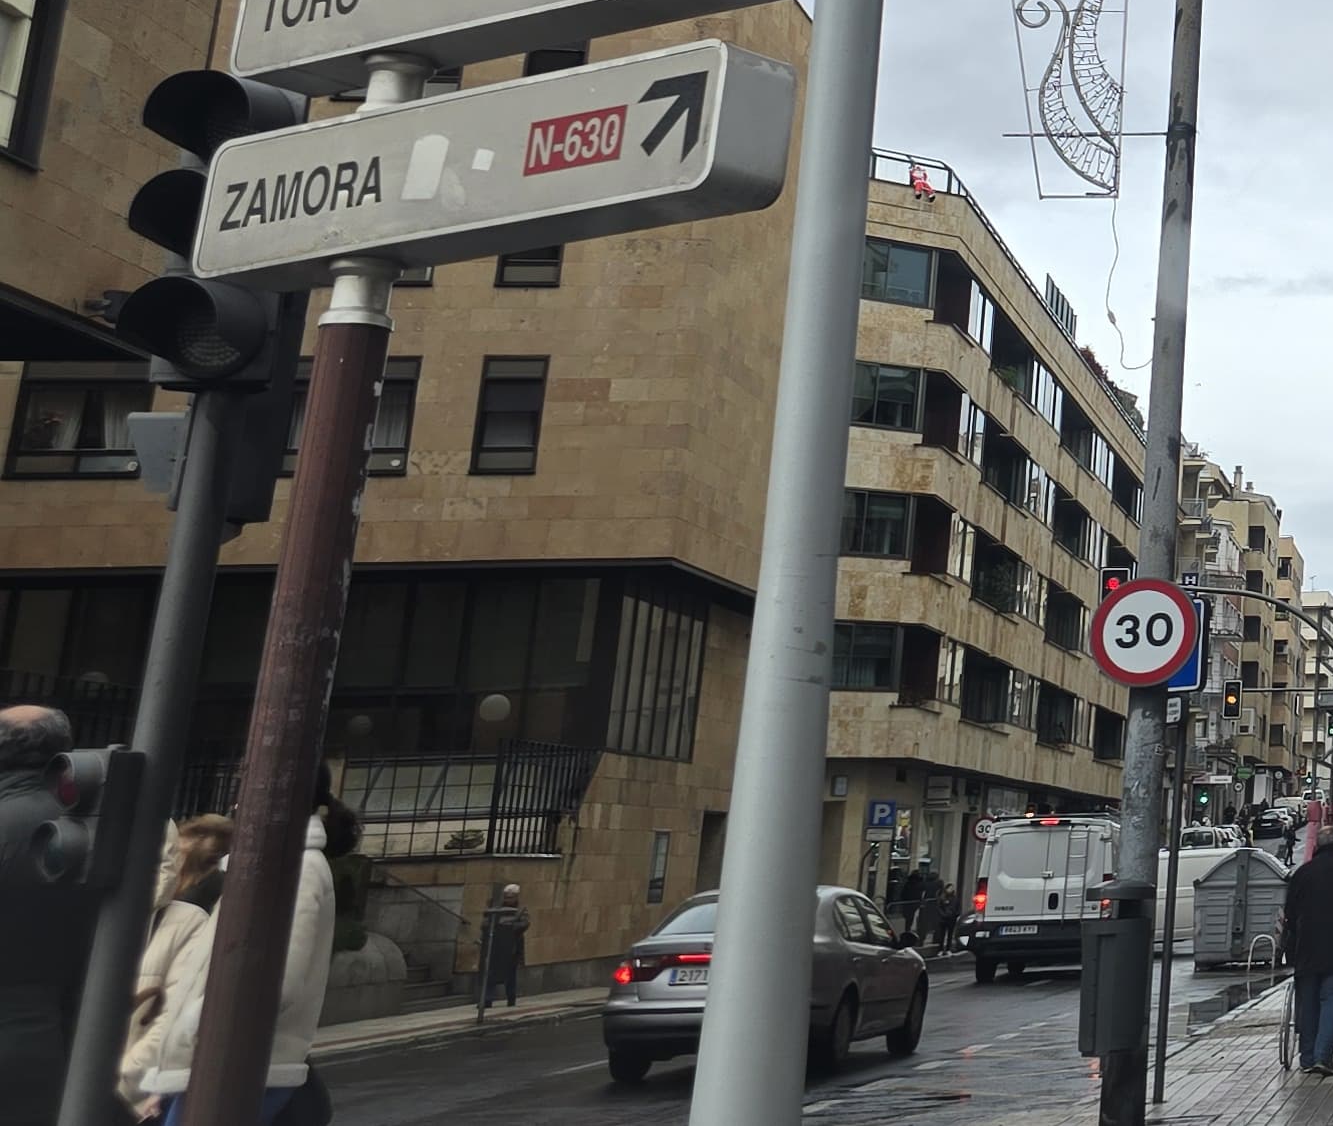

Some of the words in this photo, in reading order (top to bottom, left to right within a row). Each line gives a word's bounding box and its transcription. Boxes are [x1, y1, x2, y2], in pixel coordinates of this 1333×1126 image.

[219, 156, 382, 231] ZAMORA
[528, 113, 622, 169] N-630
[1115, 613, 1173, 648] 30
